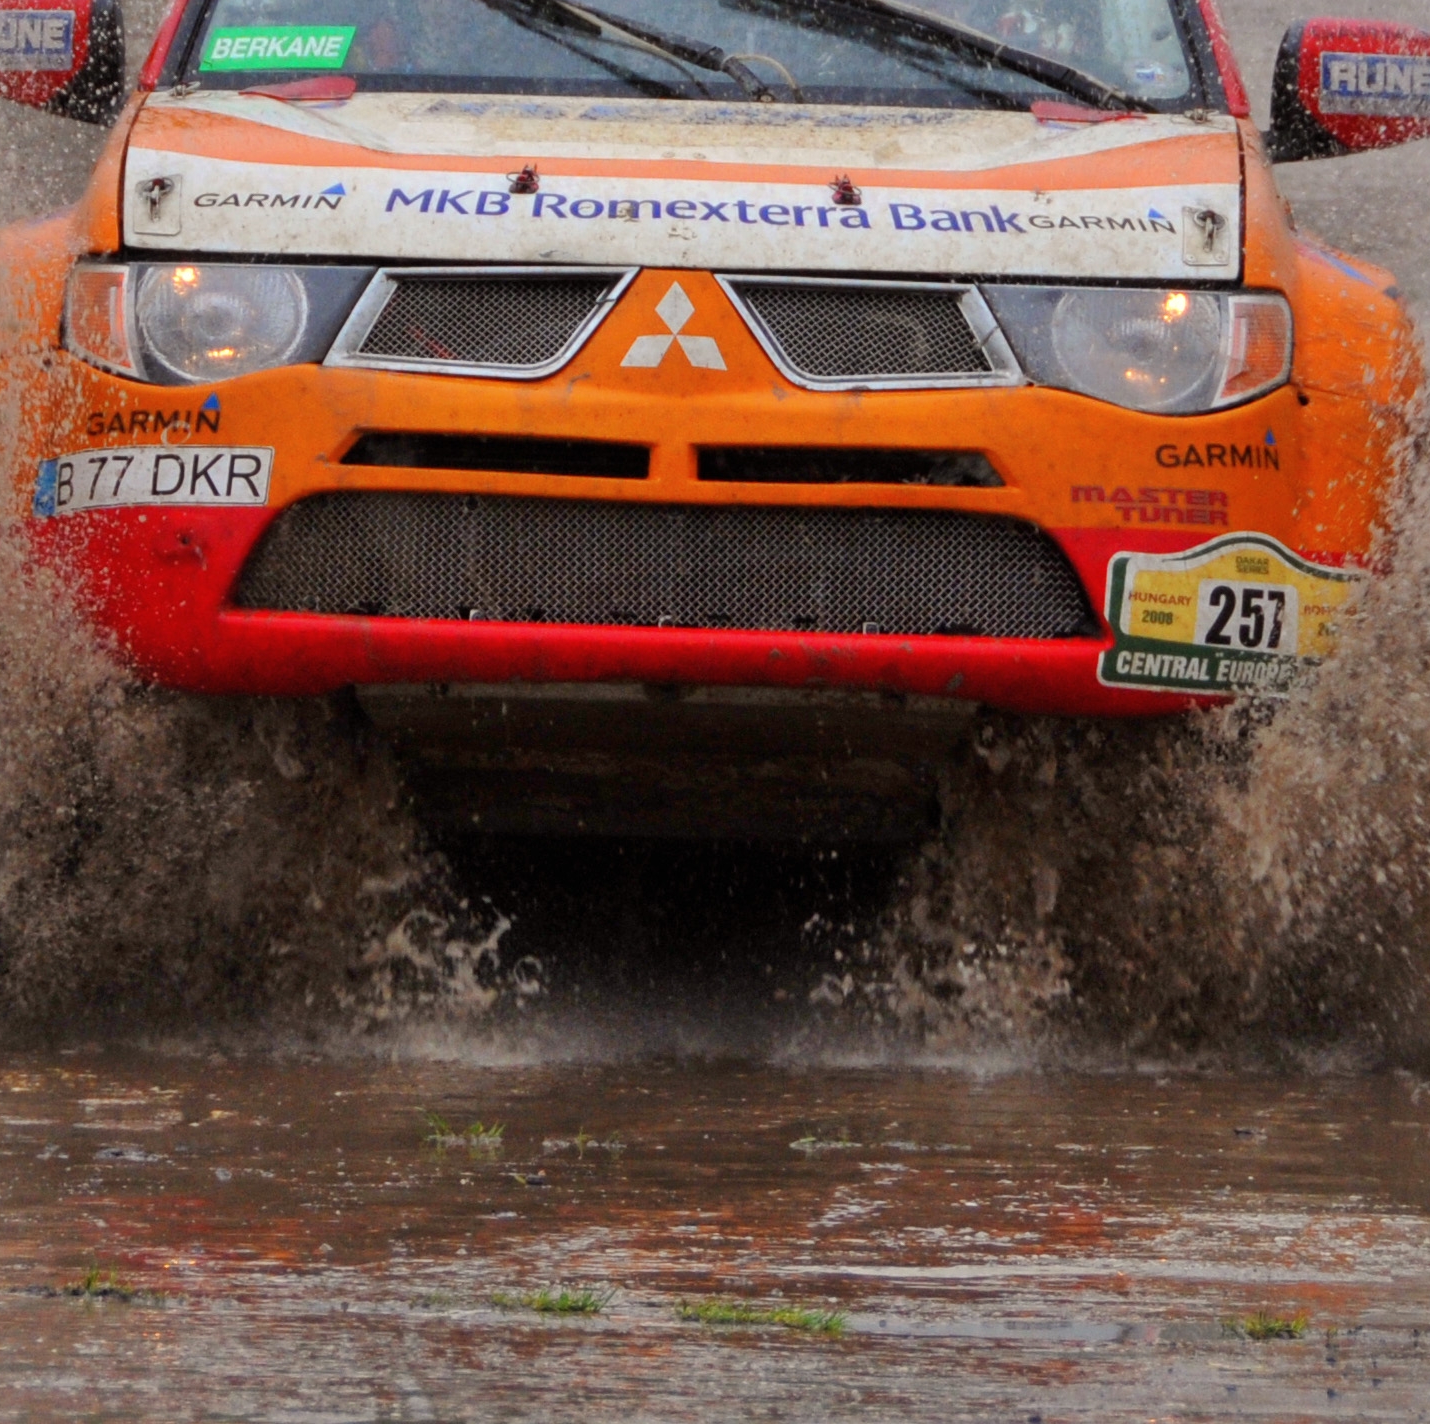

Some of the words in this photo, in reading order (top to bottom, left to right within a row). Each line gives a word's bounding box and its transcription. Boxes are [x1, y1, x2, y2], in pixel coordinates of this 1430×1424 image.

[210, 35, 345, 61] BERKANE
[193, 192, 344, 211] GARMIN
[384, 187, 512, 217] MKB
[531, 191, 873, 230] Romexterra
[888, 202, 1028, 235] Bank
[1028, 213, 1177, 235] GARMIN
[85, 409, 221, 437] GARMIN
[1155, 442, 1280, 472] GARMIN
[87, 455, 134, 501] 77
[151, 452, 262, 498] DKR
[1071, 485, 1228, 508] MASTER
[1115, 506, 1228, 526] TUNER
[1128, 590, 1192, 607] HUNGARY
[1142, 609, 1174, 626] 2008
[1205, 585, 1286, 650] 257
[1116, 650, 1209, 681] CENTRAL
